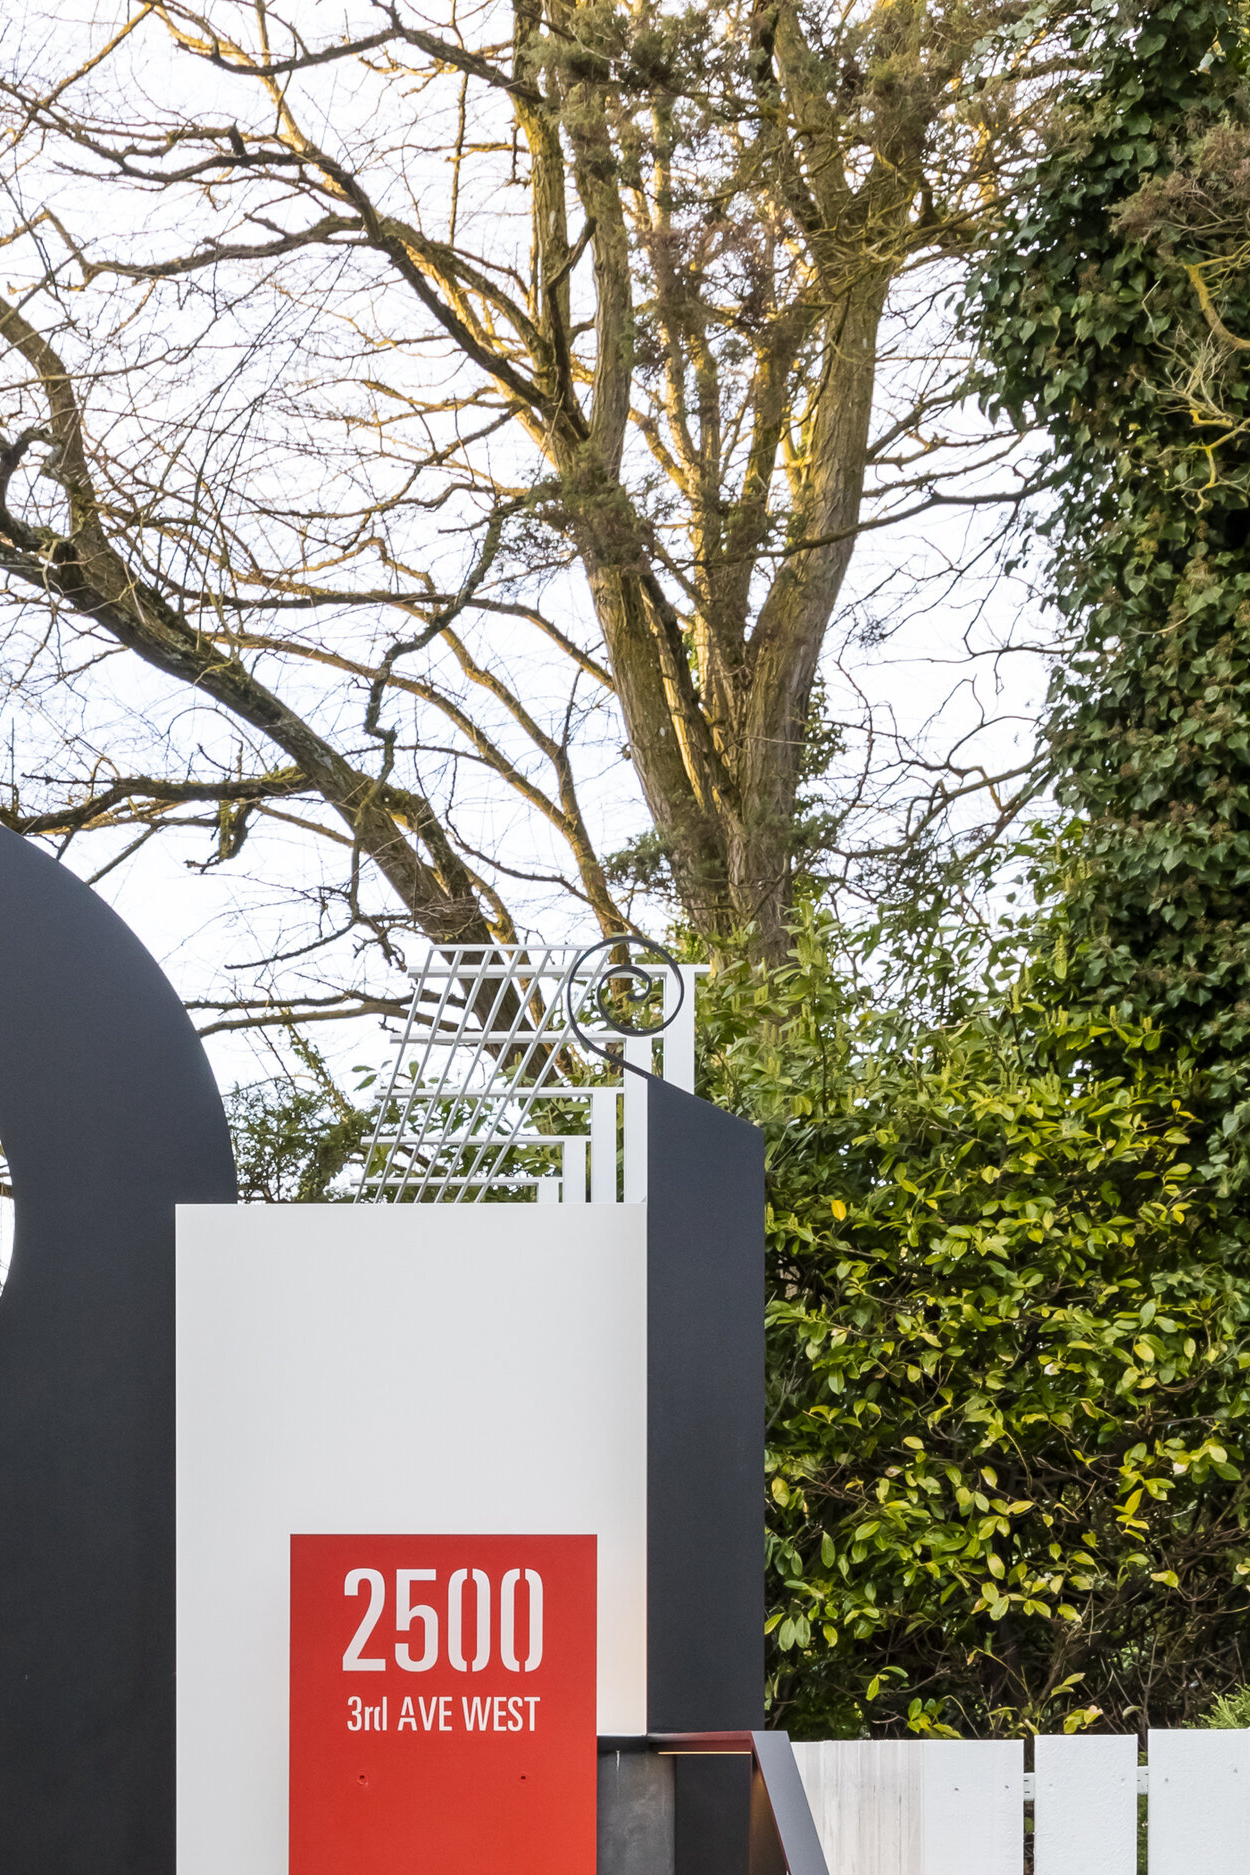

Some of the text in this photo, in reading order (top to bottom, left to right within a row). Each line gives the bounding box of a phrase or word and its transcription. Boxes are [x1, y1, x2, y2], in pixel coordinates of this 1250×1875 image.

[342, 1567, 544, 1673] 2500
[346, 1696, 541, 1732] 3rd AVE WEST
